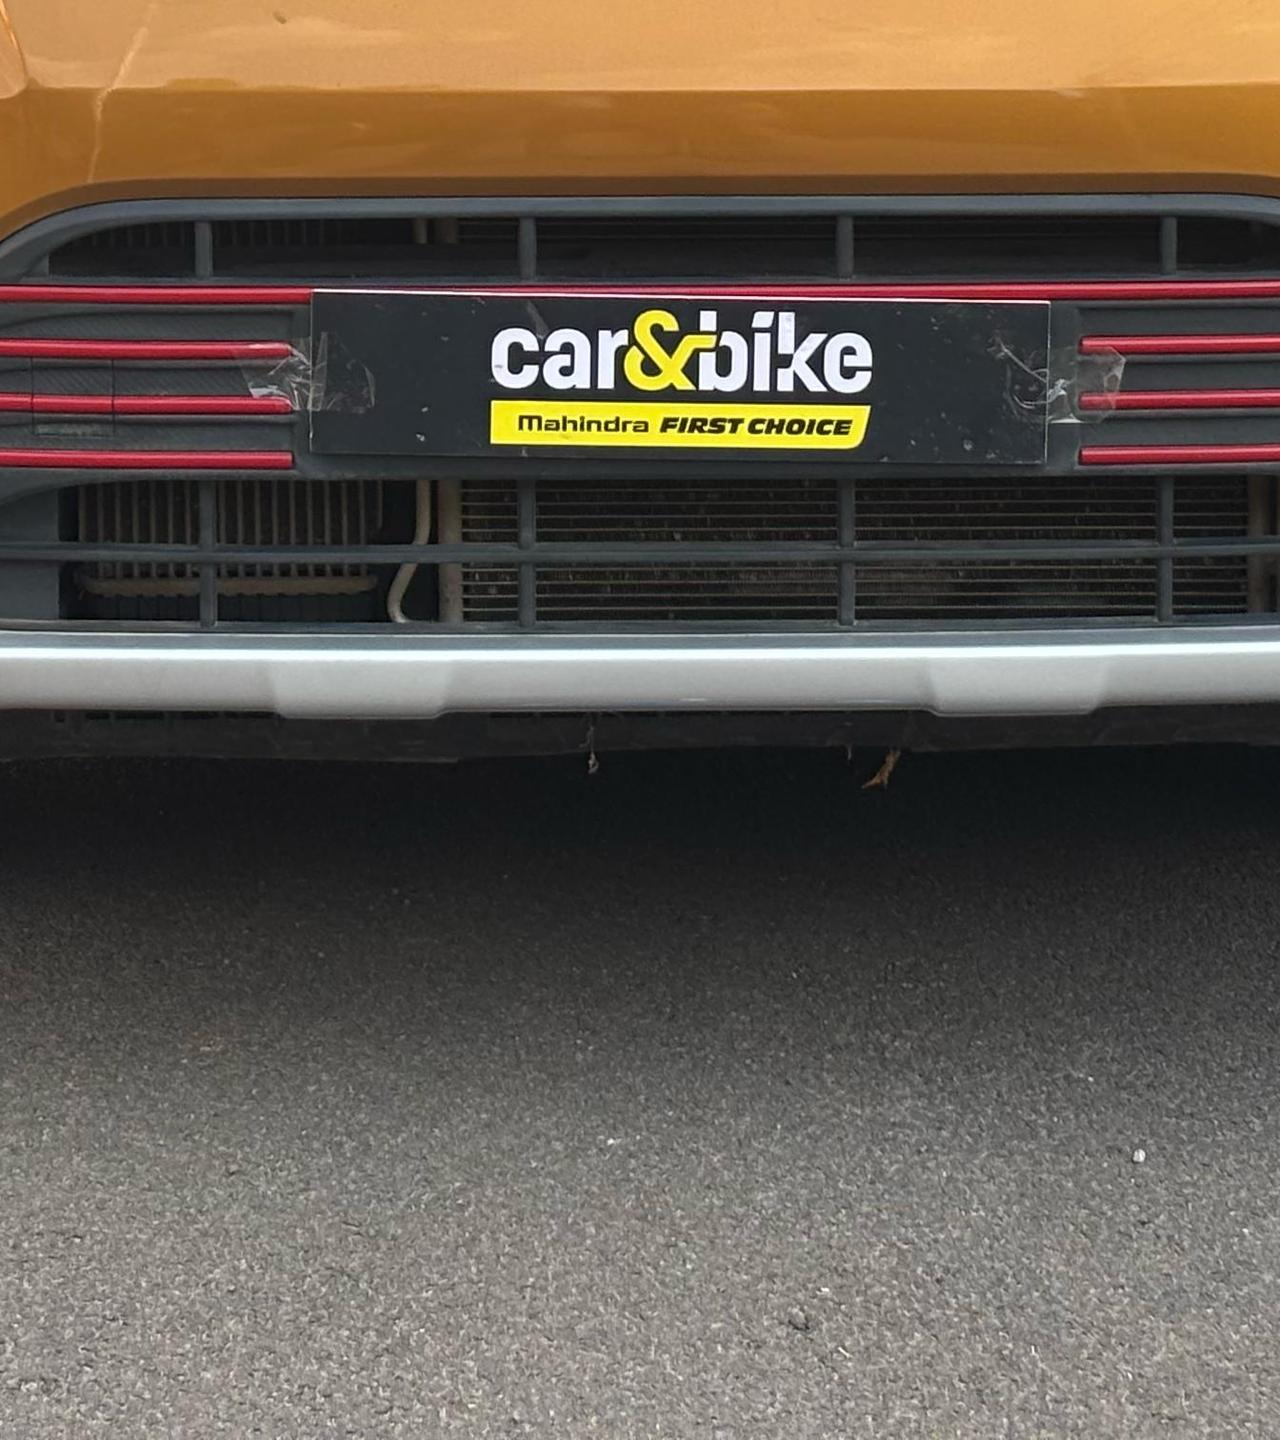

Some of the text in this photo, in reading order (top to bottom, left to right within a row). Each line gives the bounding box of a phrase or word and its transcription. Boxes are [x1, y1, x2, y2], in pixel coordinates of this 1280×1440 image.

[491, 310, 873, 394] car&bike
[519, 415, 853, 436] Mahindra FIRST CHOICE
